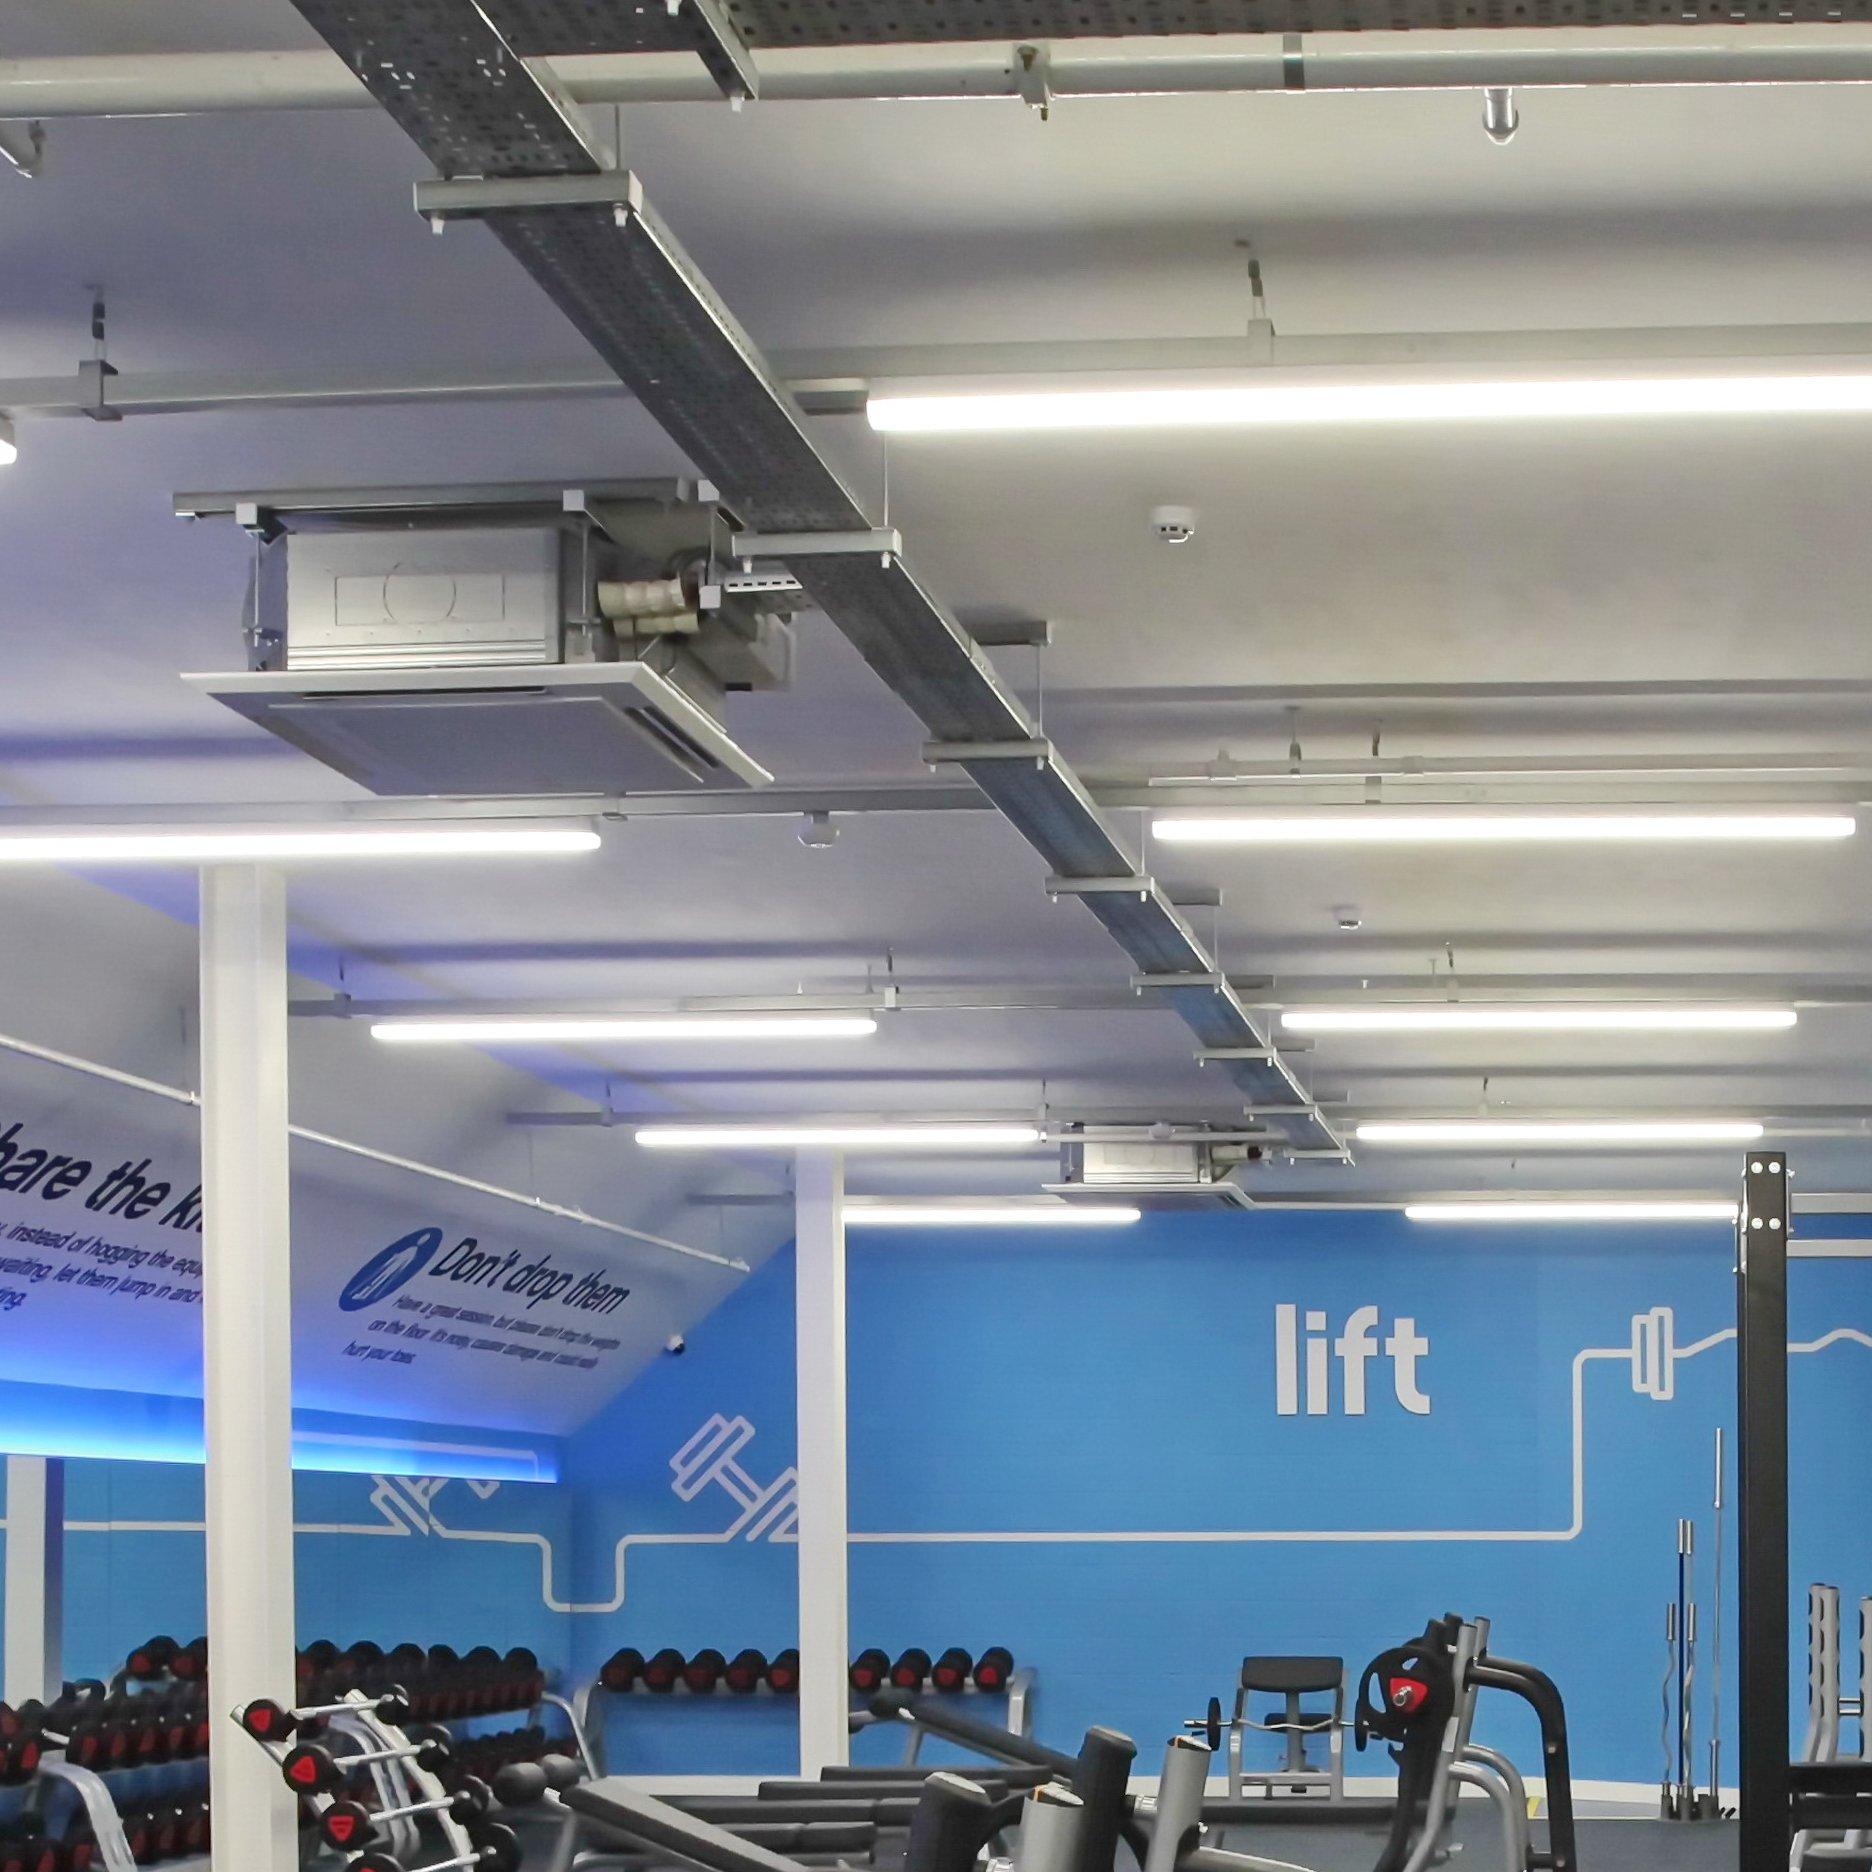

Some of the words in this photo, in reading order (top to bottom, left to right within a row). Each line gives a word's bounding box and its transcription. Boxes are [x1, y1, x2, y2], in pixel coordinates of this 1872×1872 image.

[84, 1158, 171, 1220] the
[7, 1222, 77, 1249] instead
[84, 1236, 150, 1269] hogging
[147, 1249, 175, 1268] the
[429, 1237, 521, 1288] Don't
[502, 1254, 574, 1310] drop
[562, 1269, 630, 1314] them
[76, 1267, 119, 1288] them
[1275, 1303, 1430, 1415] lift
